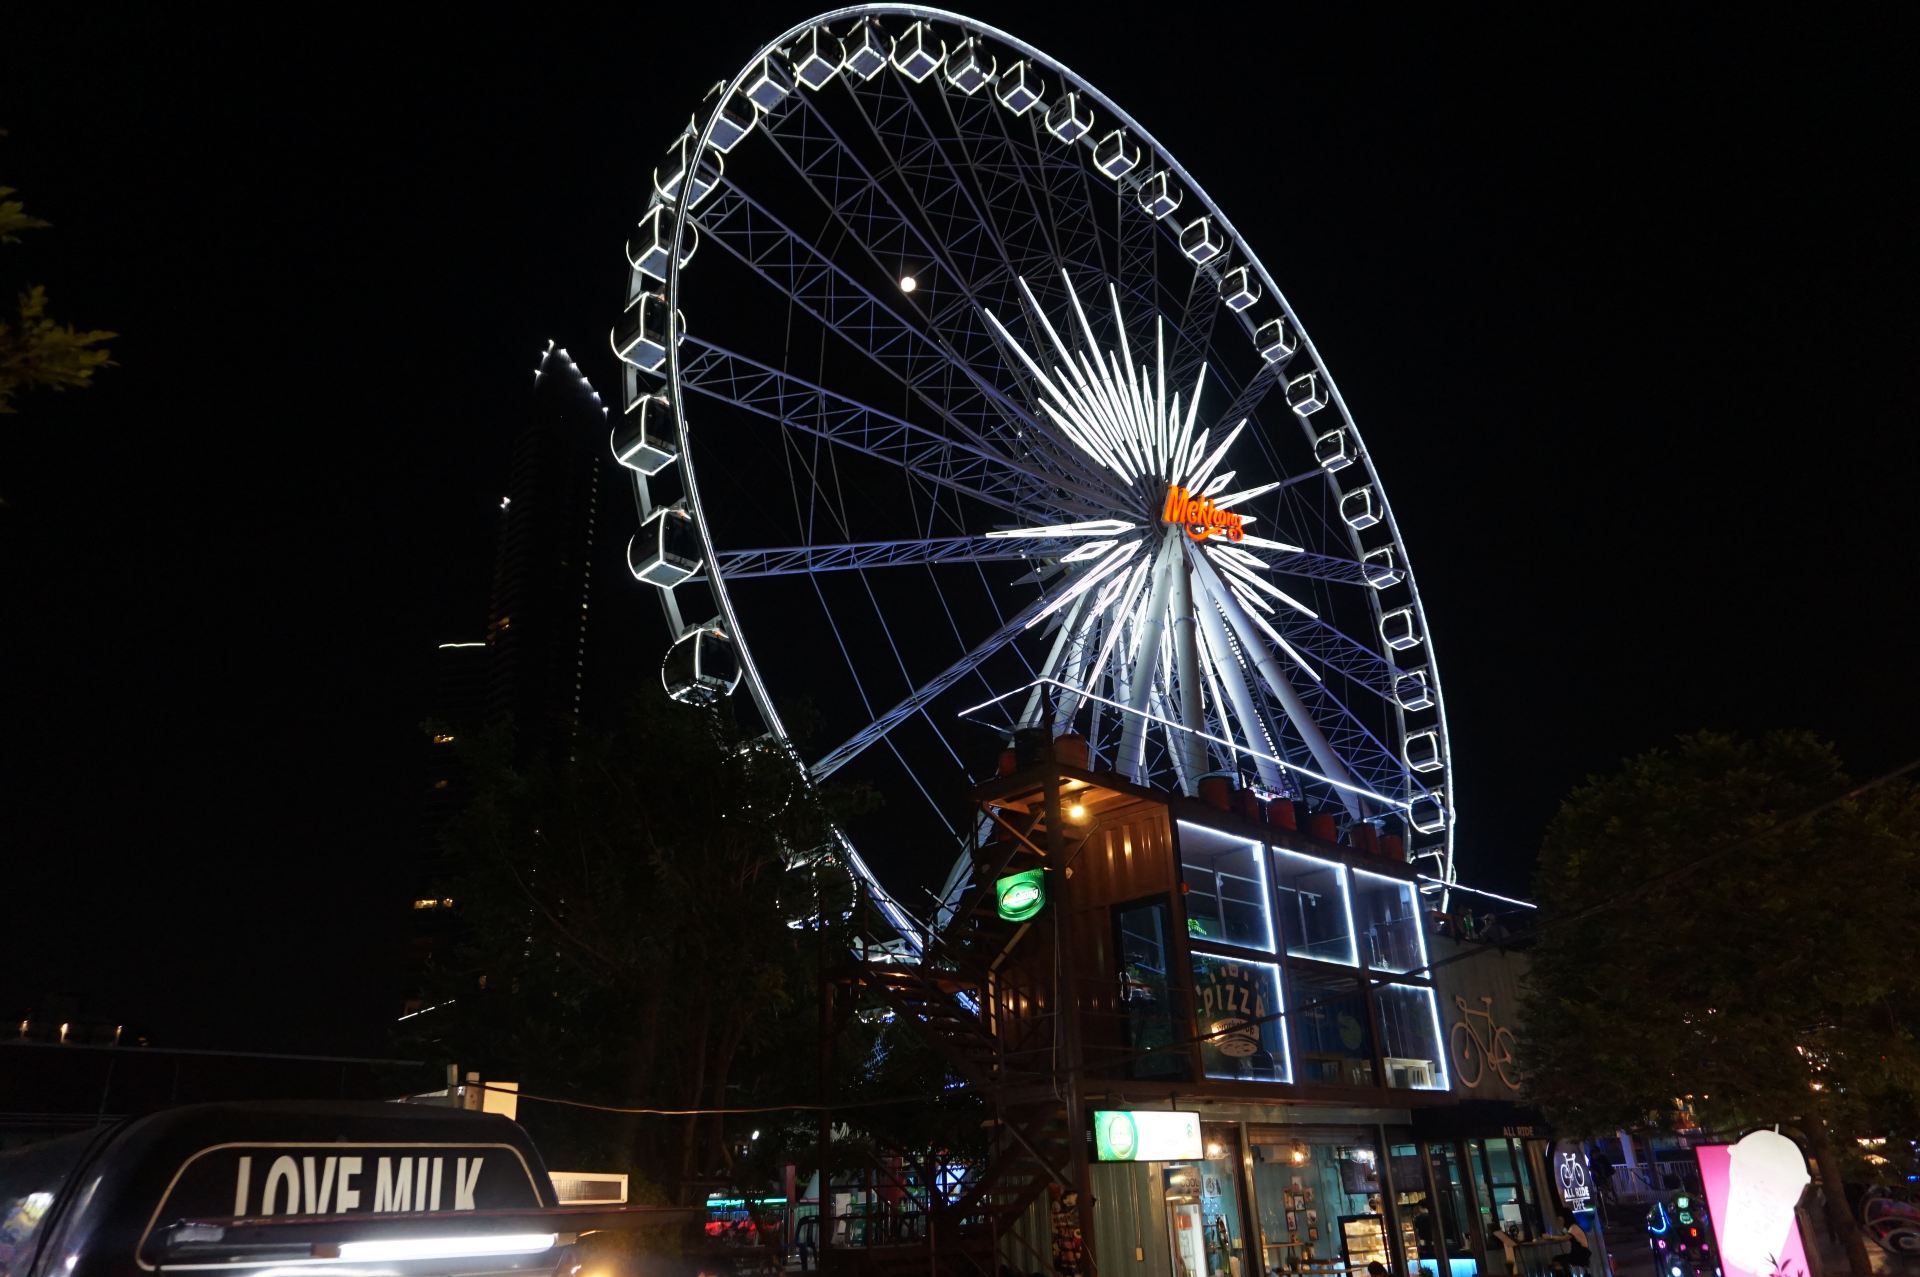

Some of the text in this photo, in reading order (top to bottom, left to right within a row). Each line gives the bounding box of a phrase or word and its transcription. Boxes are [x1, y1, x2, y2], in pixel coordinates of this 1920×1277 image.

[1163, 485, 1243, 542] Mekhong
[1203, 984, 1266, 1018] PIZZA
[1503, 1126, 1534, 1137] ALL RIDE
[234, 1155, 484, 1216] LOVE MILK
[1564, 1186, 1590, 1199] ALL RIDE
